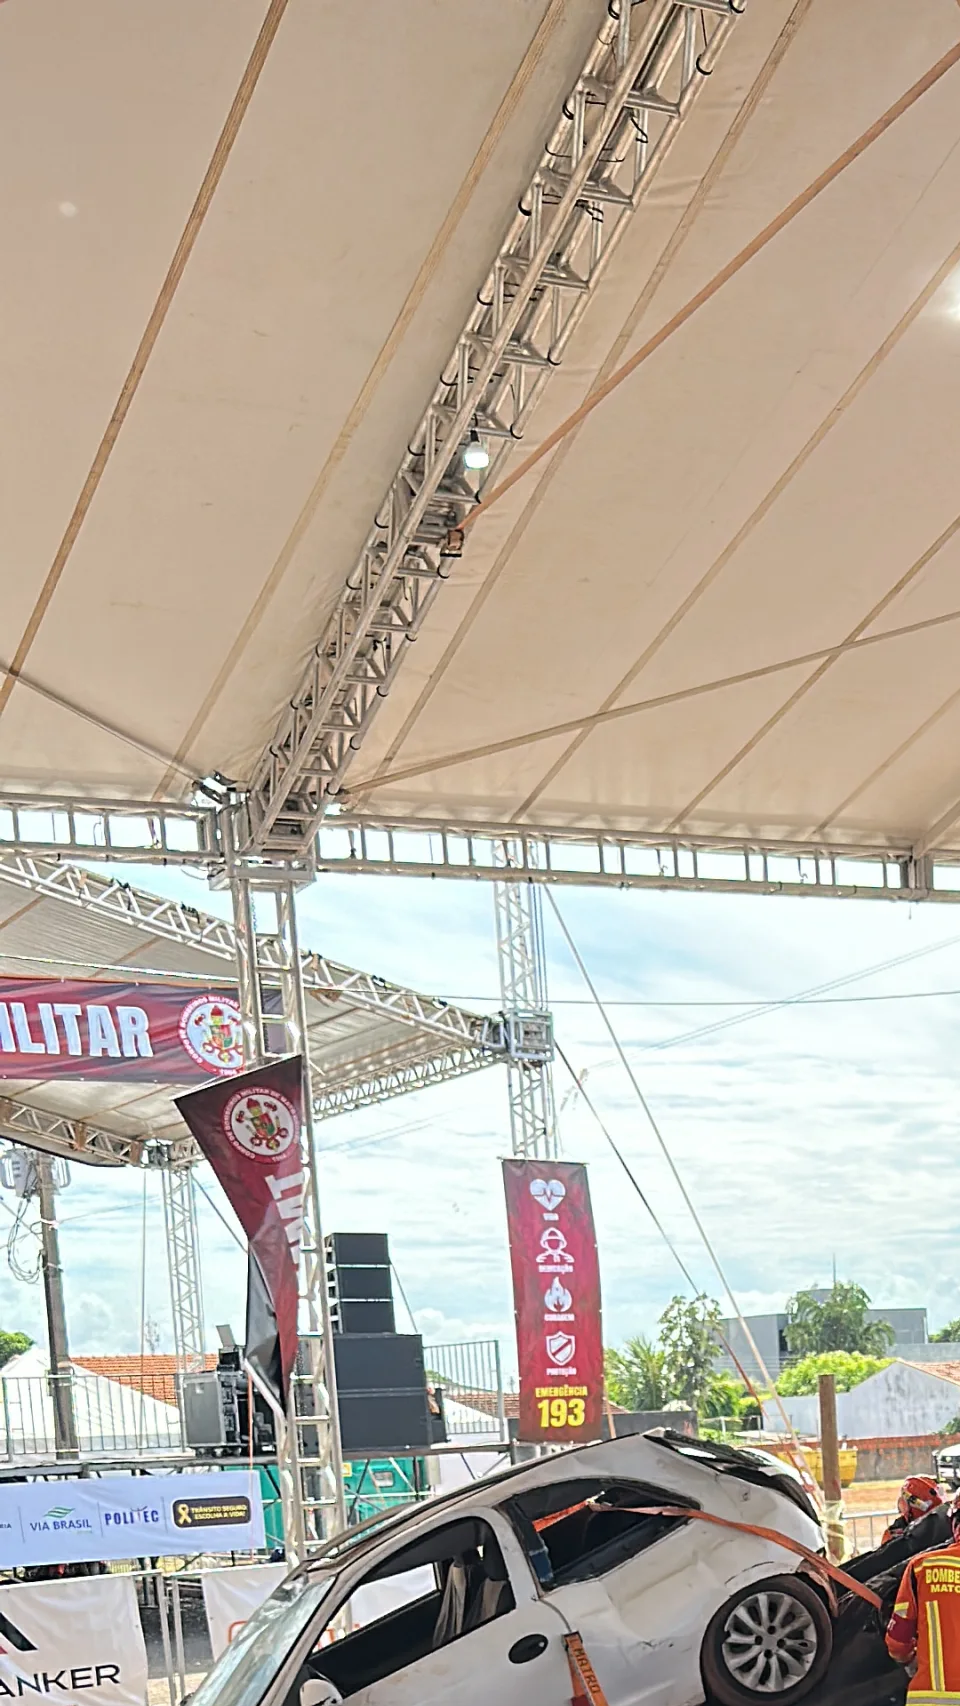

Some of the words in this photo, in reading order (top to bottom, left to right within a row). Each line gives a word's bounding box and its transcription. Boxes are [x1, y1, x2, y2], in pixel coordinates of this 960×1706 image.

[0, 1002, 154, 1057] ILITAR
[535, 1384, 588, 1397] EMERGÊNCIA
[537, 1398, 586, 1428] 193
[30, 1521, 50, 1531] VIA
[53, 1519, 92, 1530] BRASIL
[0, 1664, 121, 1698] ANKER
